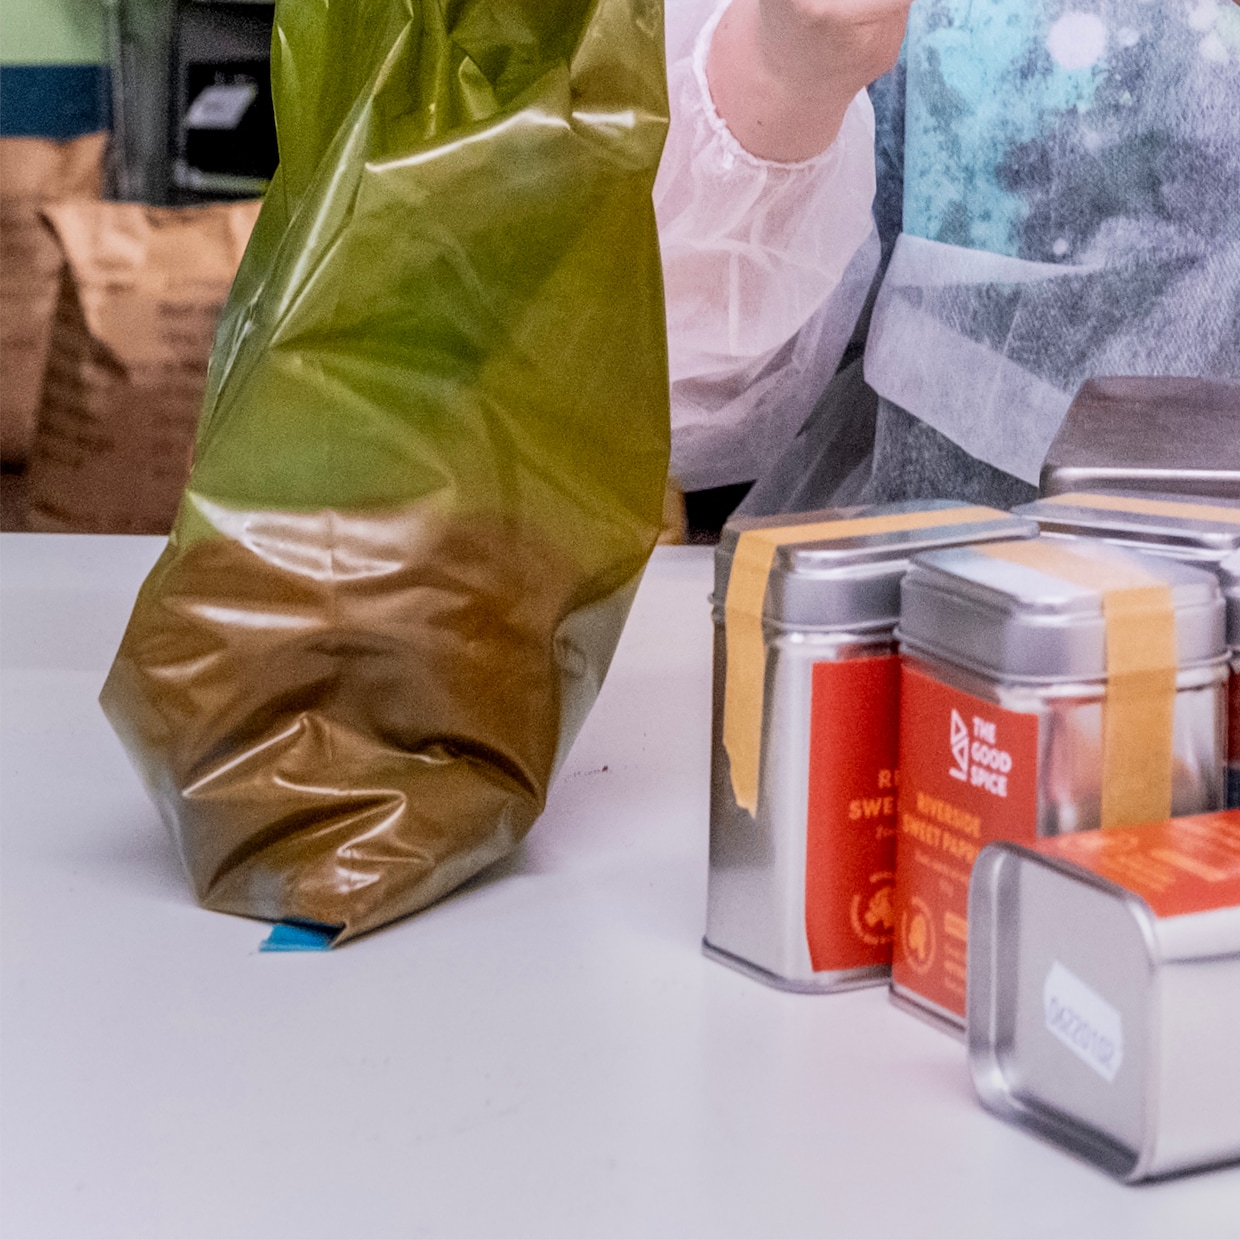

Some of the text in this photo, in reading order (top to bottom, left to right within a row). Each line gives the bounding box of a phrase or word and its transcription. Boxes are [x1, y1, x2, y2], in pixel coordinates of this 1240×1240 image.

[972, 716, 996, 744] THE
[971, 742, 1012, 774] GOOD
[970, 766, 1007, 797] SPICE
[849, 797, 894, 820] SWE
[942, 830, 980, 865] PAPR
